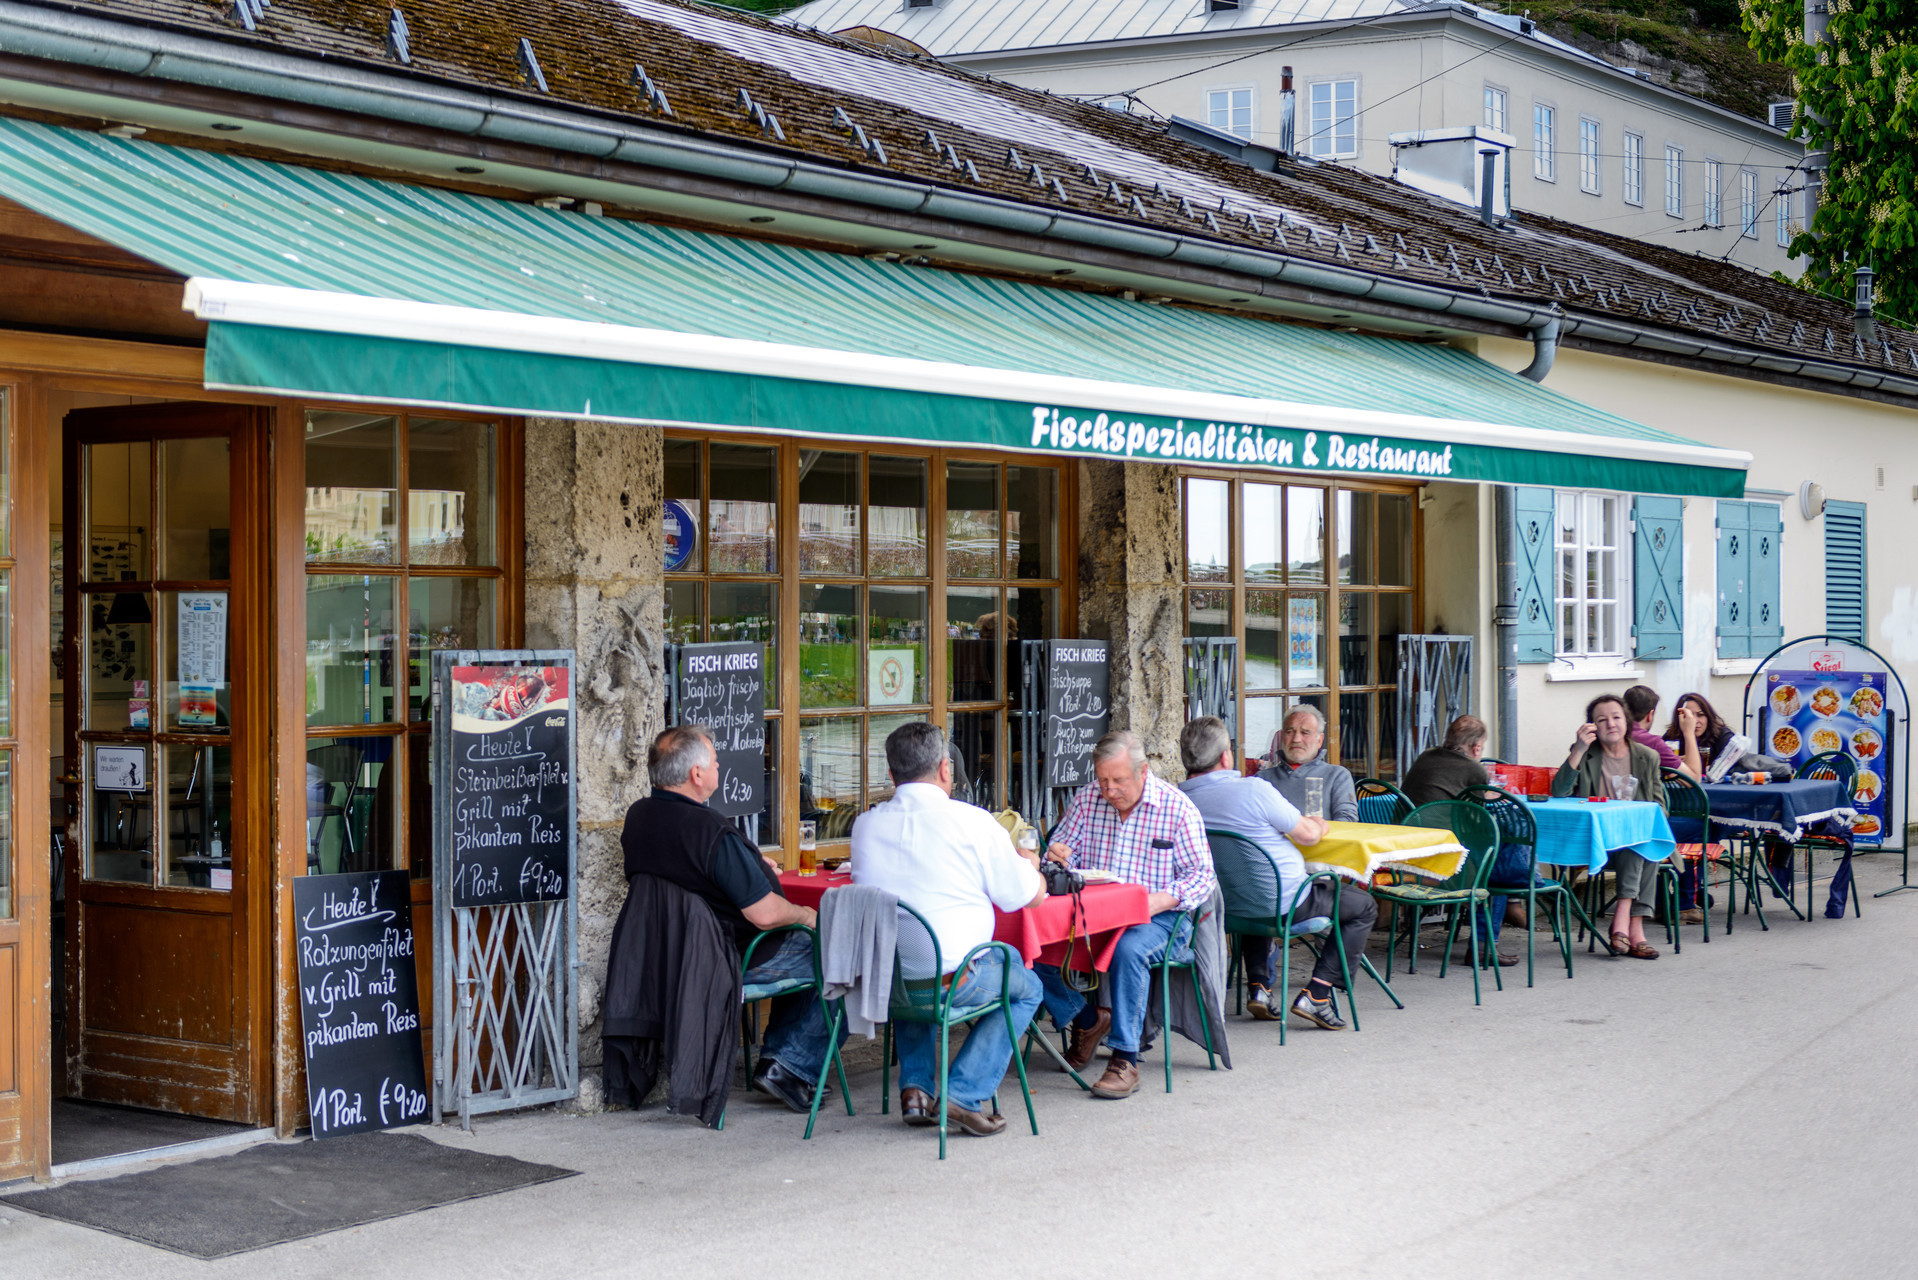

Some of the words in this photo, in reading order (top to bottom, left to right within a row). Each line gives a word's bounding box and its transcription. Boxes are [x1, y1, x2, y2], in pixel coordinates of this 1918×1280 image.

[1030, 406, 1293, 465] Fischspezialitäten
[1302, 432, 1320, 466] &
[1326, 434, 1453, 475] Restaurant
[689, 655, 721, 673] FISCH
[724, 652, 758, 671] KRIEG
[1056, 648, 1080, 662] FISCH
[1081, 648, 1106, 662] KRIEG
[682, 676, 725, 709] Täglich
[728, 674, 760, 709] frische
[1050, 665, 1092, 698] Fischsuppe
[1059, 697, 1064, 713] 1
[1053, 721, 1077, 744] Auch
[1078, 727, 1094, 739] zum
[455, 761, 561, 804] Steinbeißerfilet
[1052, 758, 1059, 784] 1
[1060, 759, 1080, 783] Liter
[1084, 759, 1095, 783] 11
[454, 795, 494, 836] Grill
[501, 793, 532, 817] mit
[456, 822, 522, 861] pikantem
[528, 814, 561, 844] Reis
[323, 878, 380, 920] Heute!
[454, 863, 465, 899] 1
[469, 863, 502, 897] Port.
[300, 927, 414, 975] Rotzungenfilet
[318, 969, 362, 1018] Grill
[368, 968, 397, 995] mit
[307, 1011, 379, 1059] pikantem
[381, 999, 417, 1035] Reis
[313, 1087, 328, 1132] 1
[329, 1088, 367, 1128] Port.
